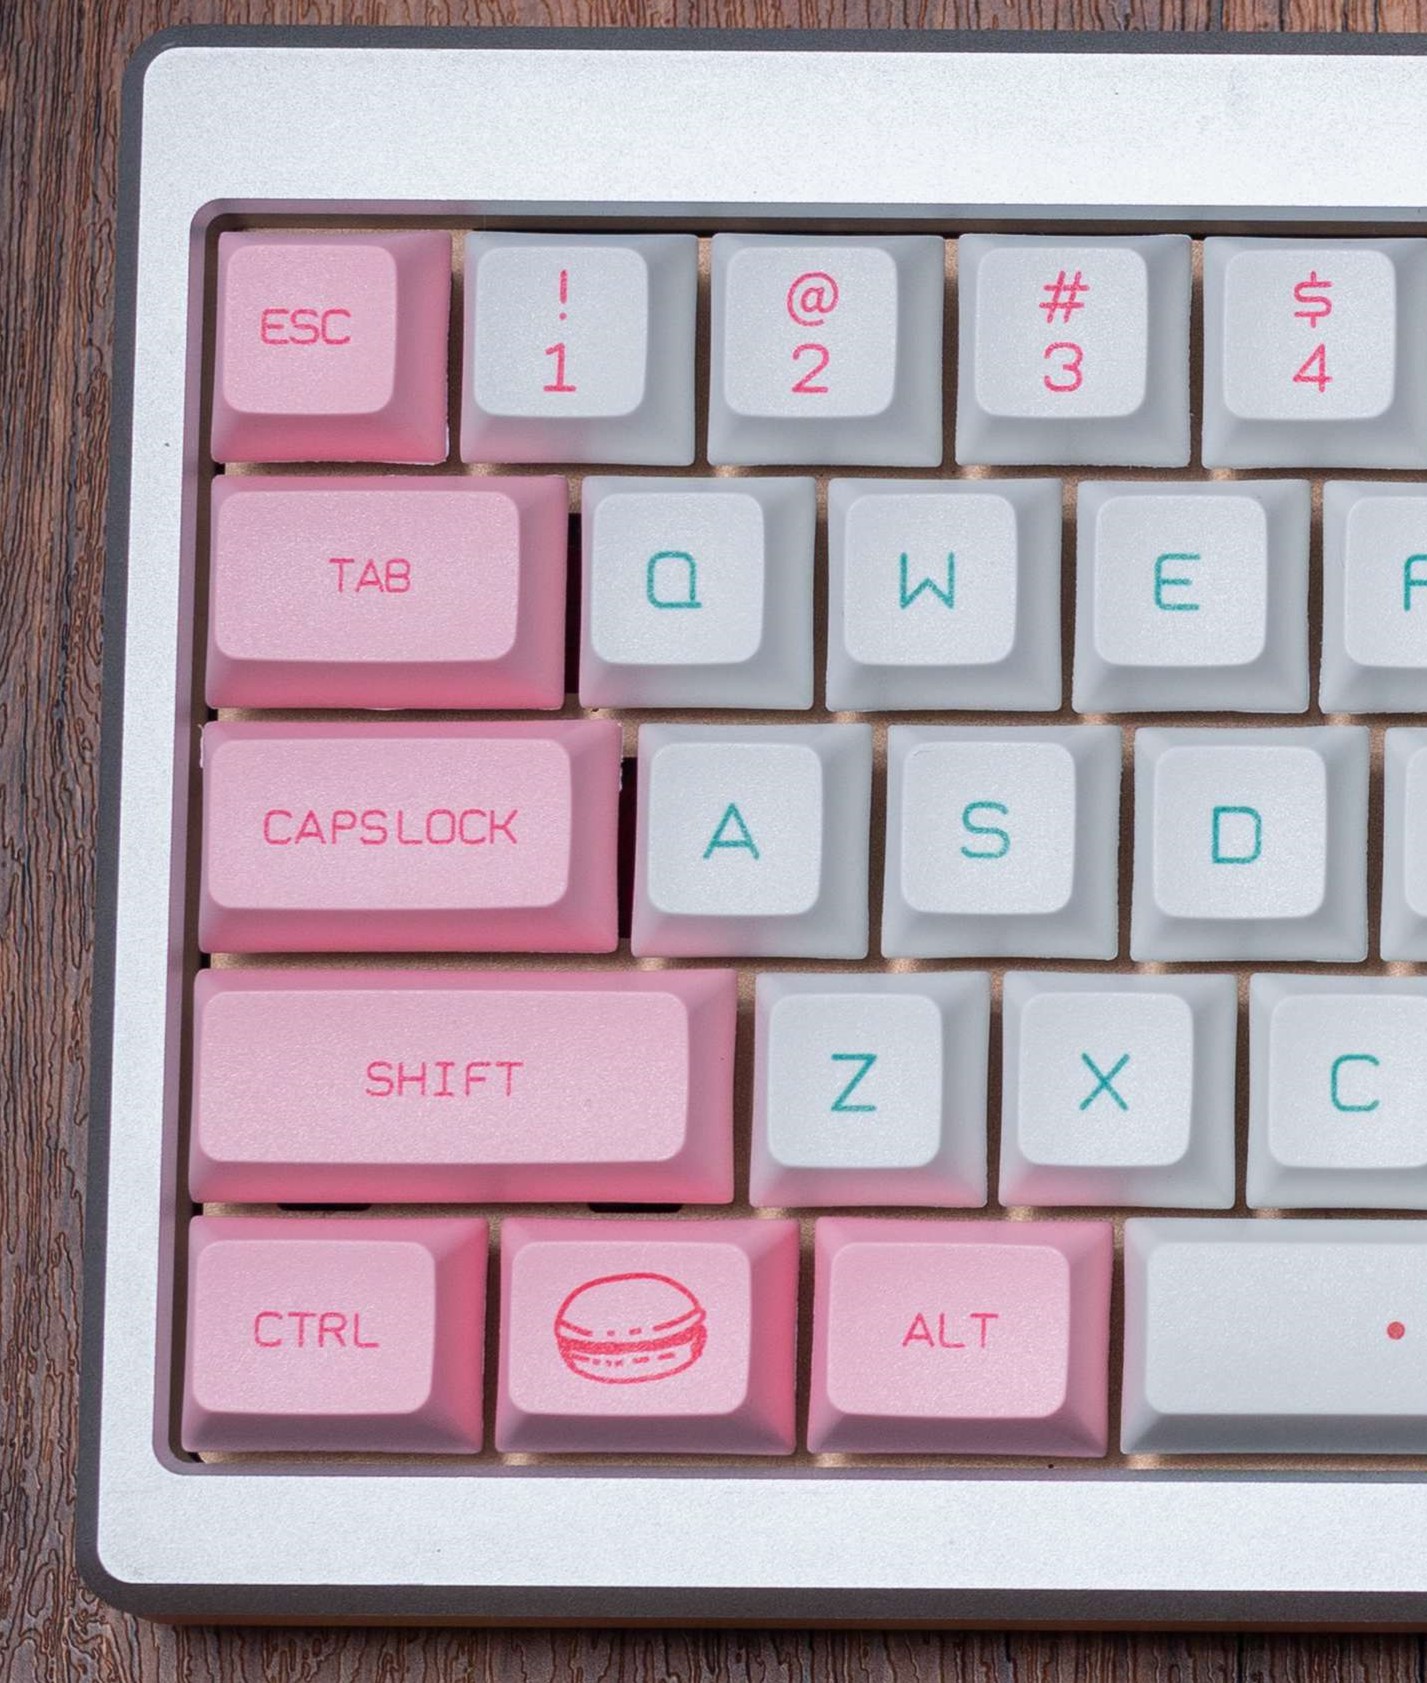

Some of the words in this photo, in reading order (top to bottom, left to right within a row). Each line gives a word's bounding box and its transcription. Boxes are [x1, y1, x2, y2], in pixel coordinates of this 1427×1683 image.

[786, 271, 840, 328] @
[1038, 270, 1090, 324] #
[1293, 270, 1333, 329] $
[260, 307, 352, 346] ESC
[543, 342, 577, 393] 1
[791, 342, 830, 394] 2
[1043, 341, 1084, 393] 3
[1292, 343, 1333, 393] 4
[328, 557, 412, 594] TAB
[646, 550, 703, 610] Q
[899, 551, 956, 610] W
[1153, 552, 1201, 612] E
[262, 808, 519, 846] CAPSLOCK
[702, 802, 761, 860] A
[960, 800, 1011, 860] S
[1211, 805, 1263, 865] D
[365, 1060, 524, 1098] SHIFT
[830, 1052, 878, 1113] Z
[1079, 1052, 1130, 1112] X
[1330, 1053, 1381, 1113] C
[253, 1310, 380, 1349] CTRL
[901, 1312, 1000, 1349] ALT
